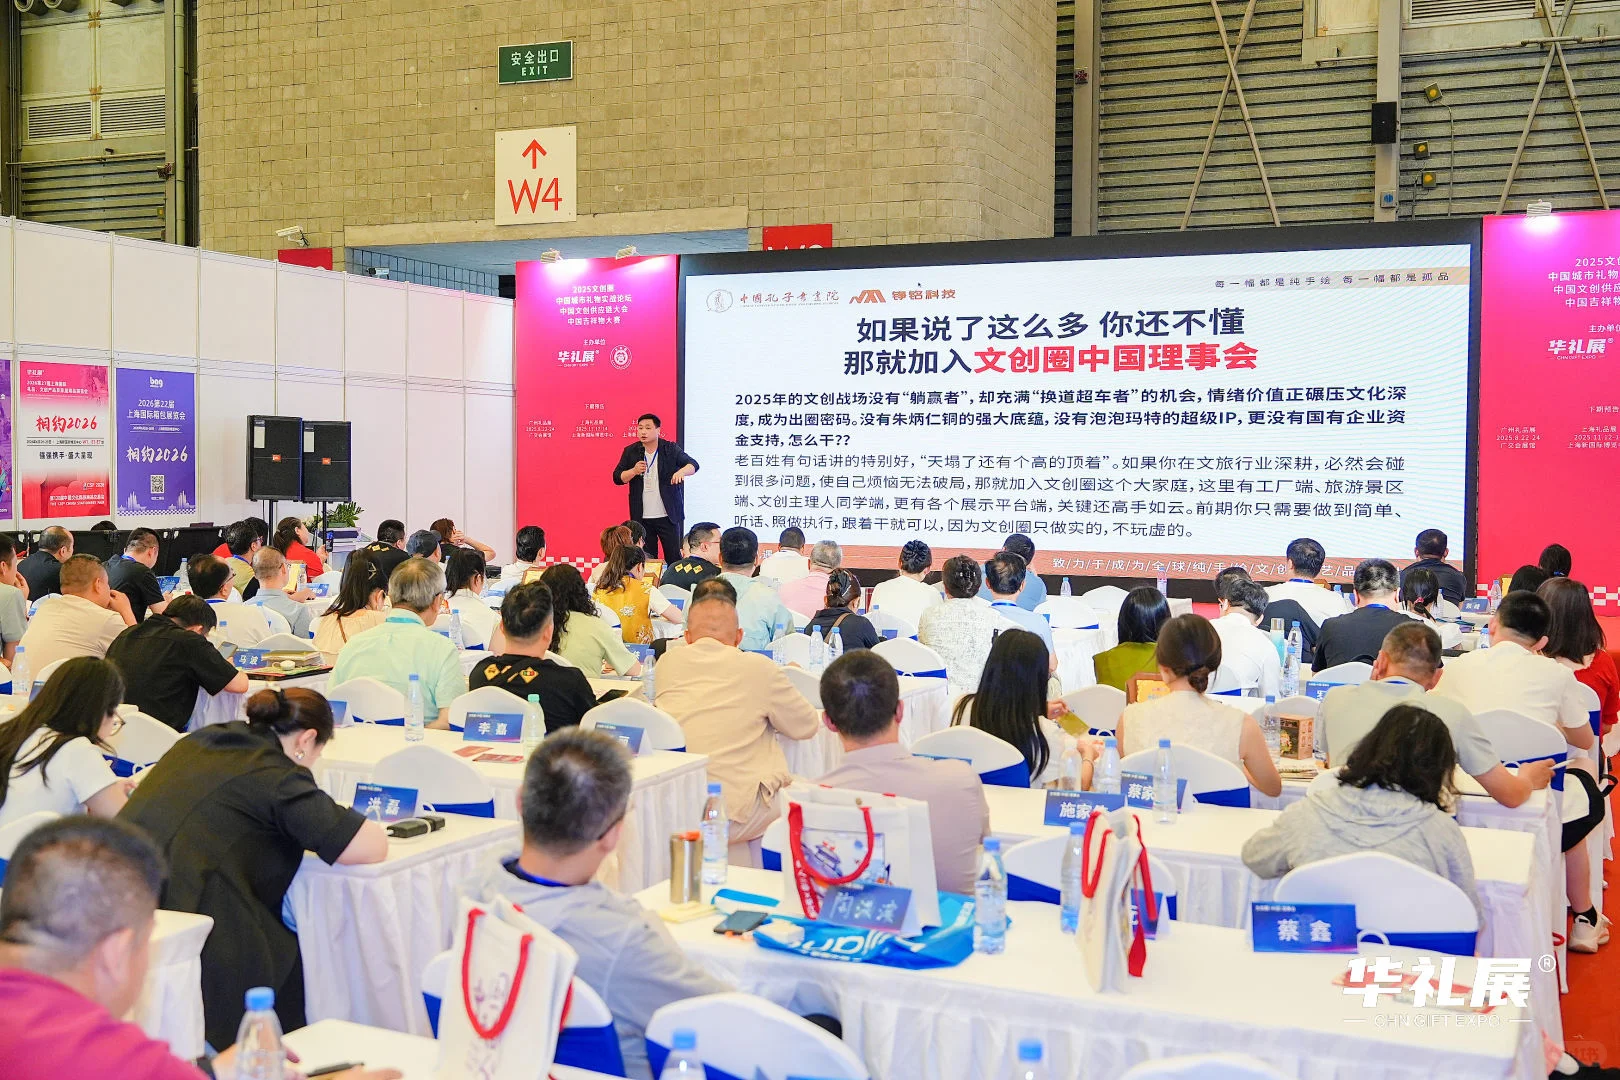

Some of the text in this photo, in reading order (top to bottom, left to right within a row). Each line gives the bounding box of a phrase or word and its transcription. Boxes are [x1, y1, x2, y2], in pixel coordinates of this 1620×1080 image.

[511, 49, 560, 66] 安全出口
[521, 66, 549, 77] EXIT
[507, 177, 563, 215] W4
[1575, 256, 1620, 267] 2025文
[1215, 272, 1449, 288] 每一幅都是纯手绘 每一幅都是孤品
[1548, 270, 1619, 281] 中国城市礼物
[560, 305, 628, 315] 中国文创供应链大会
[857, 307, 1246, 344] 如果说了这么多 你还不懂
[844, 341, 1259, 376] 那就加入文创圈中国理事会
[36, 415, 98, 433] 相约2026
[1567, 441, 1620, 449] 上海新国际博览
[126, 445, 188, 463] 相约2026
[1277, 918, 1332, 943] 蔡鑫
